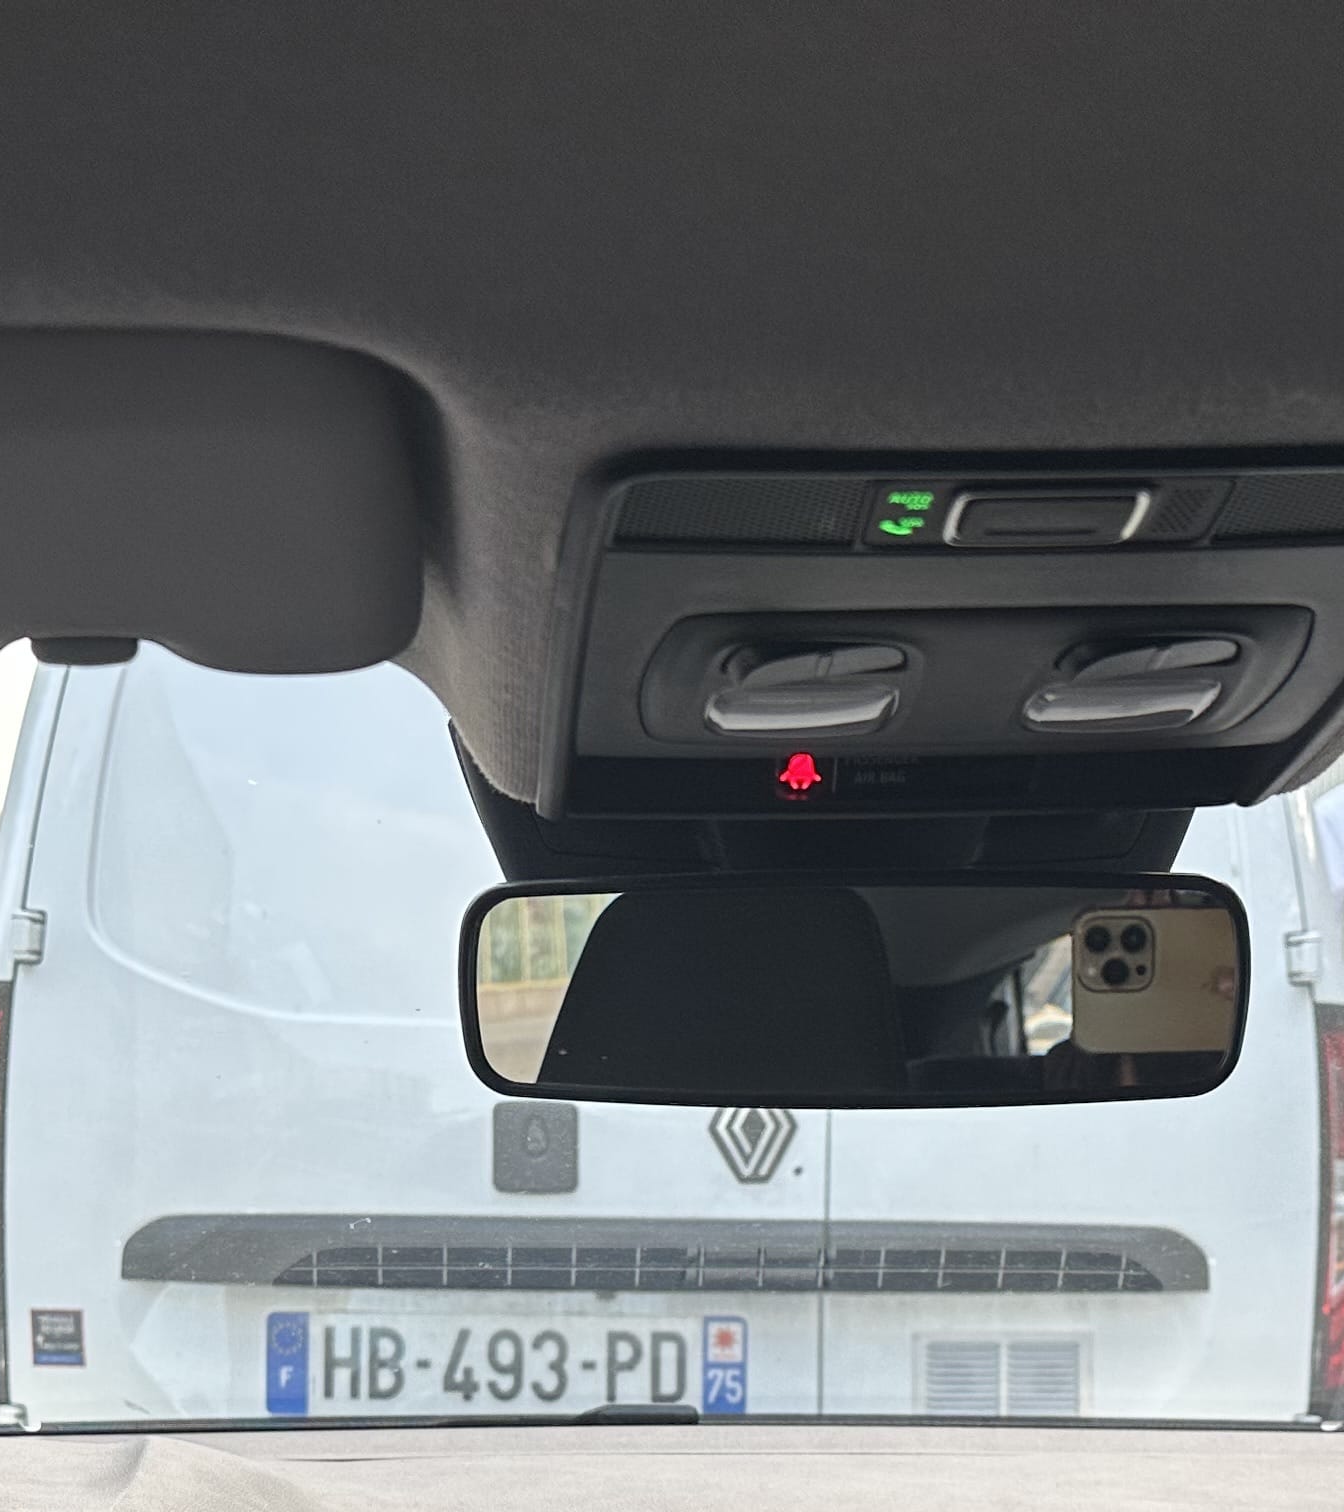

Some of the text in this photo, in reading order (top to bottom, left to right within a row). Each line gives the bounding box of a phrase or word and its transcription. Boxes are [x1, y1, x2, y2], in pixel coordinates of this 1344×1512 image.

[888, 491, 934, 504] AUTO
[279, 1326, 743, 1403] F HB-493-PD 75
